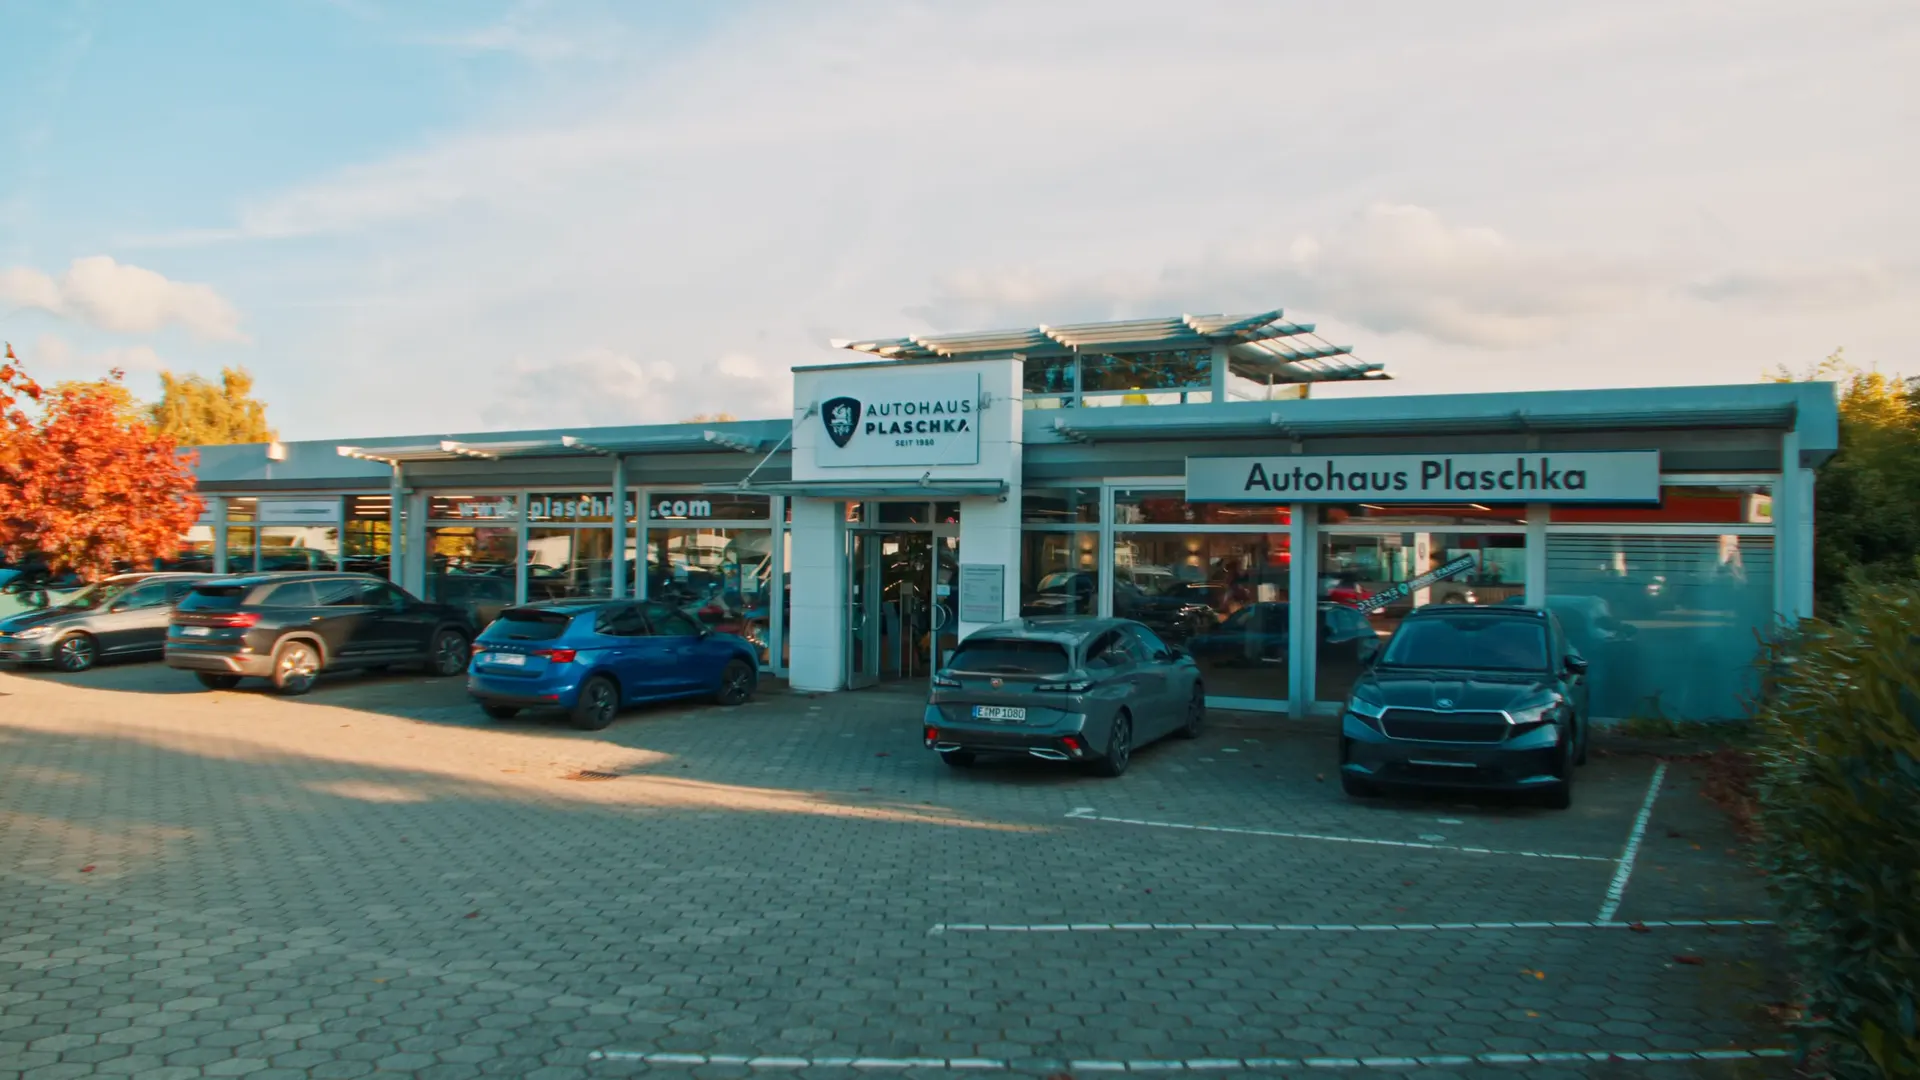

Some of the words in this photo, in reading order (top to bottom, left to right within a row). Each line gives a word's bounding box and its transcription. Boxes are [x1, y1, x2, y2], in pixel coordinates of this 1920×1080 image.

[866, 399, 970, 416] AUTOHAUS
[865, 418, 970, 435] PLASCHKA
[895, 439, 913, 447] SEIT
[1244, 460, 1408, 491] Autohaus
[1421, 457, 1586, 490] Plaschka
